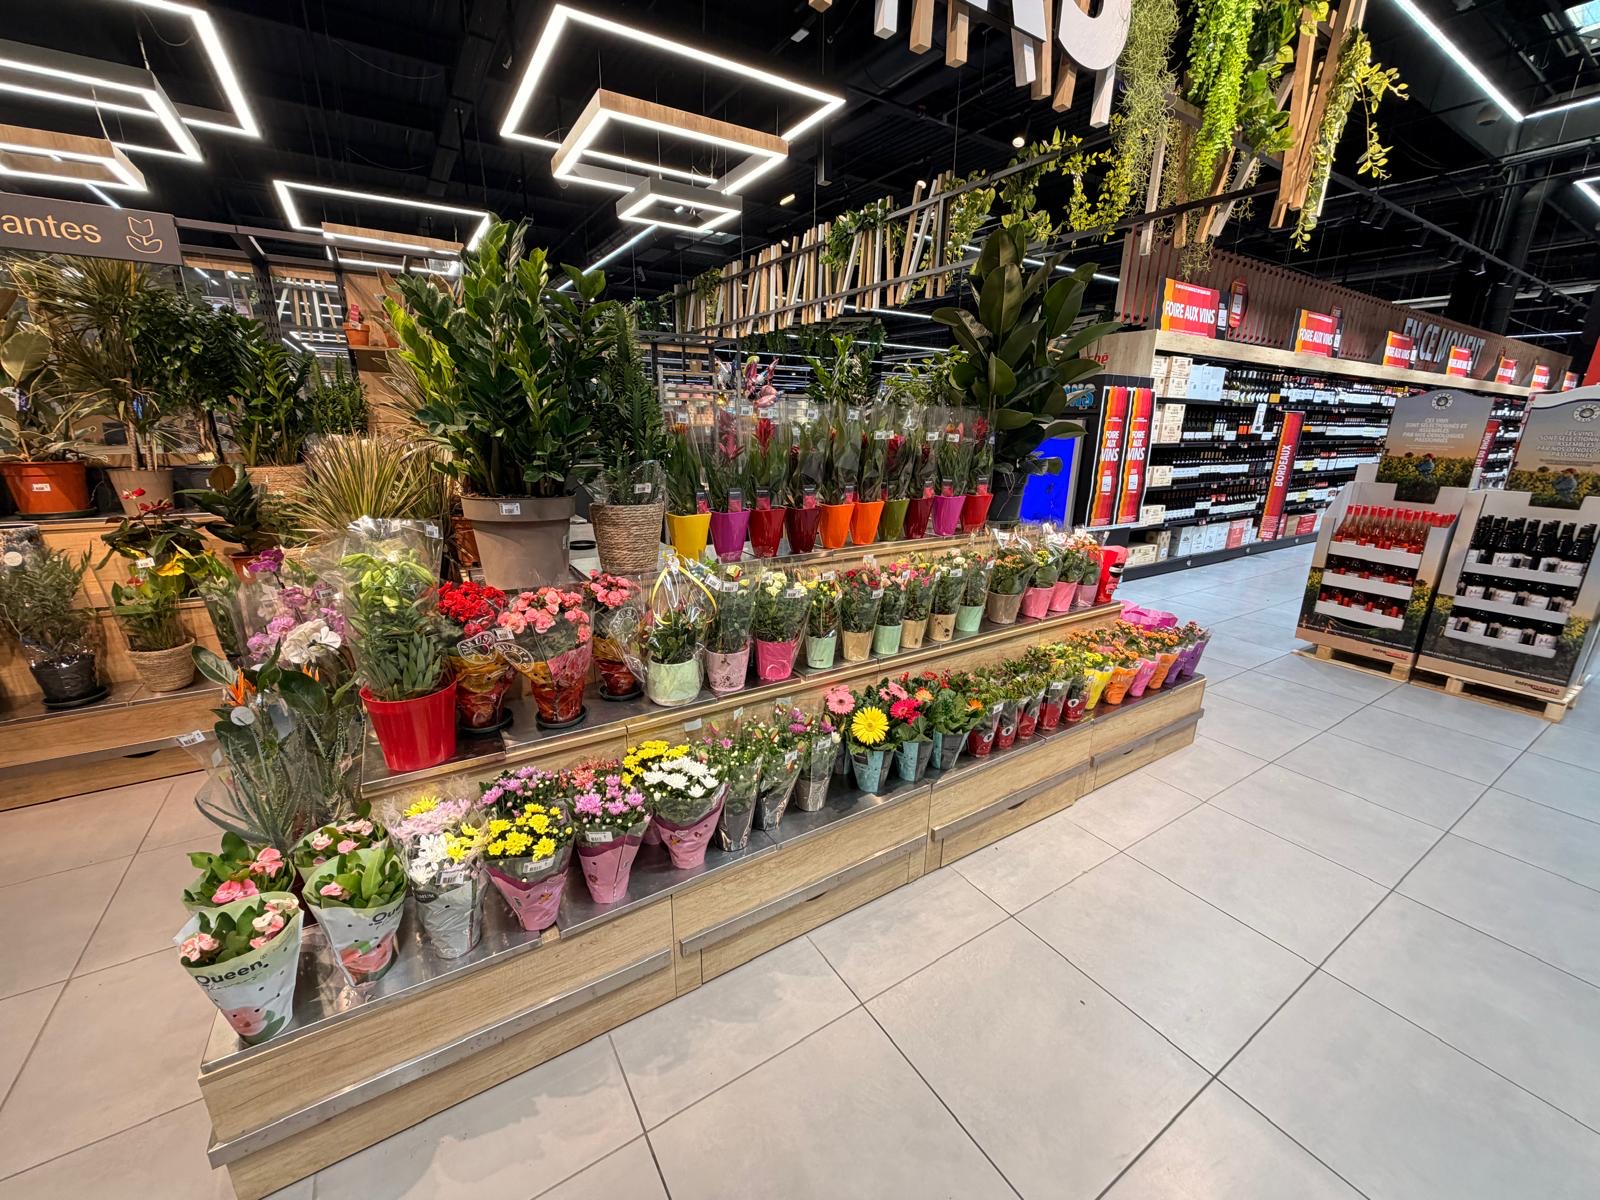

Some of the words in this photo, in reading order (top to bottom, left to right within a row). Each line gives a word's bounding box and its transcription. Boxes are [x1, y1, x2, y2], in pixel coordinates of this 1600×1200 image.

[0, 214, 102, 244] antes
[1165, 300, 1185, 318] FOIRE
[1184, 305, 1199, 322] AUX
[1199, 307, 1216, 325] VINS
[1299, 327, 1313, 342] FOIRE
[1313, 331, 1323, 345] AUX
[1322, 332, 1334, 346] VINS
[1419, 324, 1440, 361] CE
[1105, 430, 1120, 439] FOIRE
[1131, 430, 1146, 439] FOIRE
[1106, 439, 1117, 448] AUX
[1132, 439, 1143, 447] AUX
[1101, 448, 1120, 461] VINS
[1127, 447, 1145, 461] VINS
[1273, 444, 1292, 487] BORDEAUX
